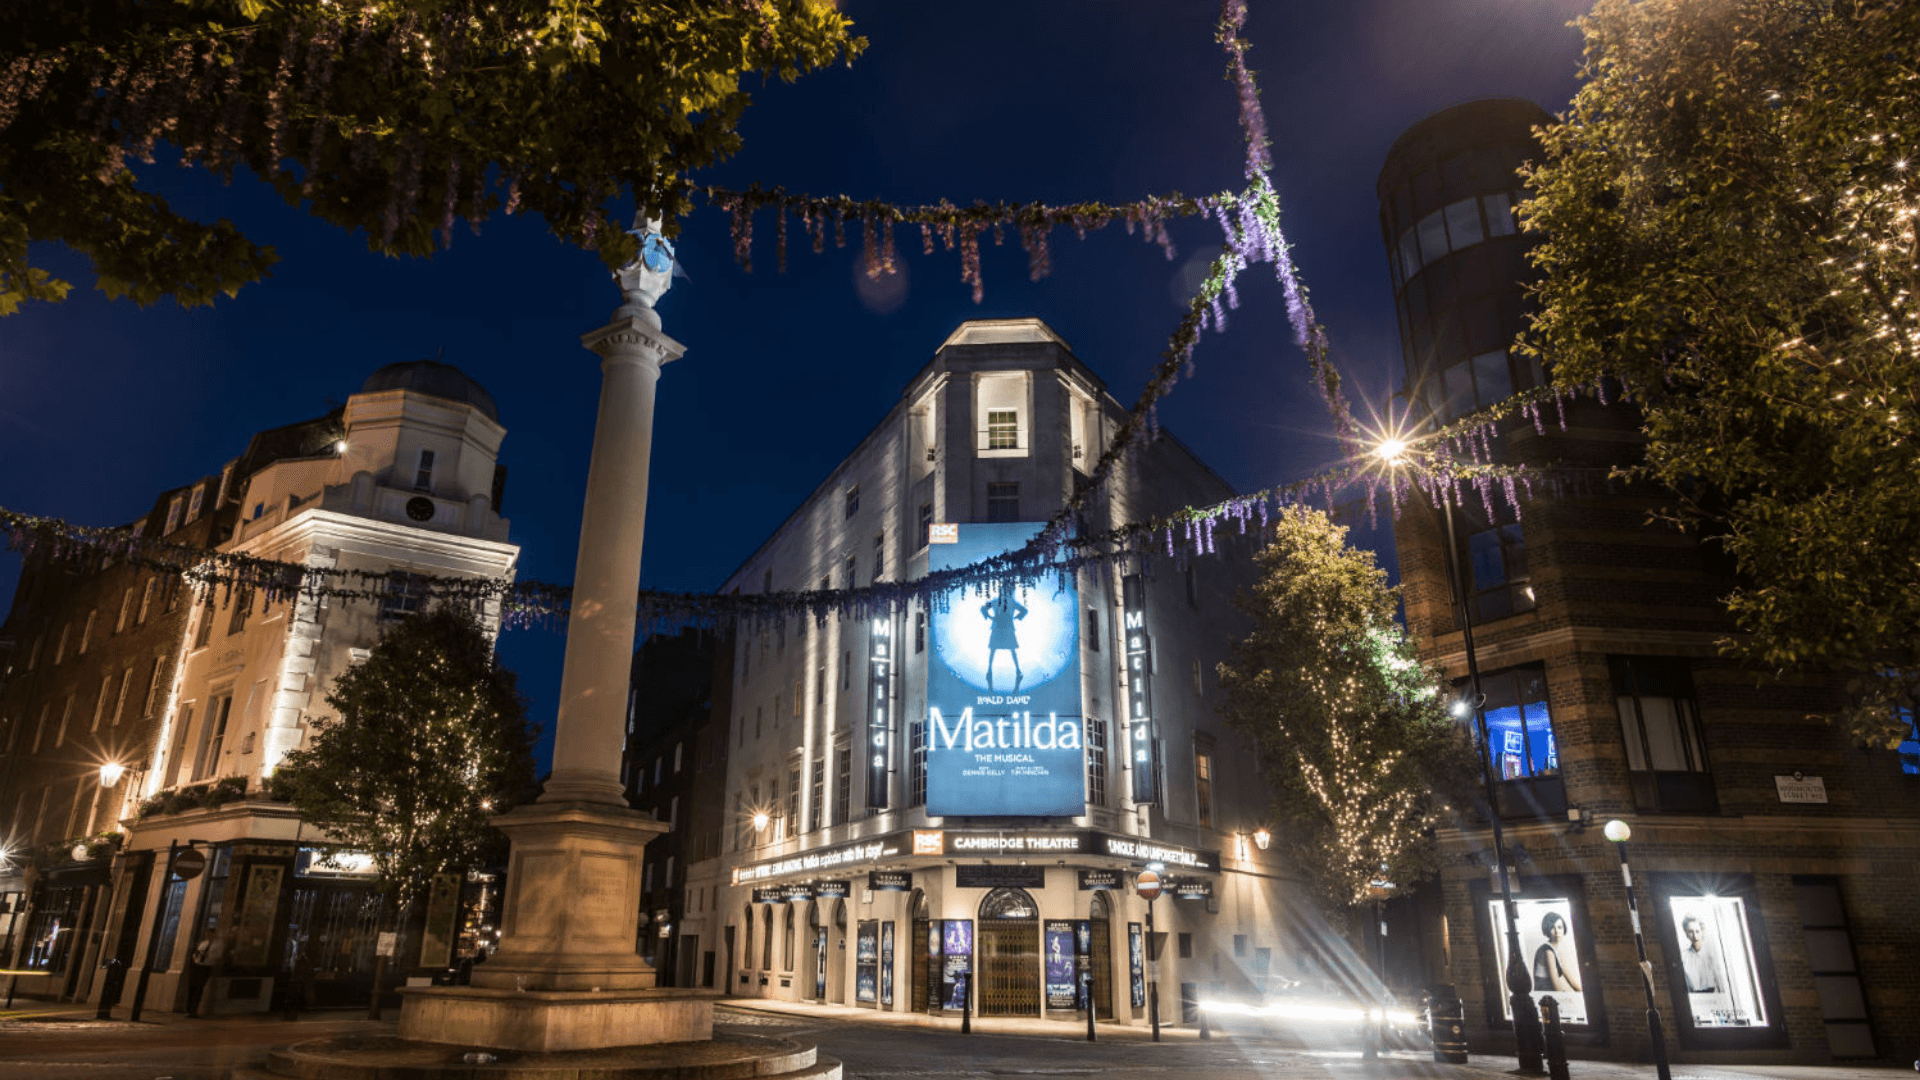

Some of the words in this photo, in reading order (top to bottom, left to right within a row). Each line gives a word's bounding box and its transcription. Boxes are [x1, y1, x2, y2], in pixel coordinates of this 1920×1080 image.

[931, 524, 956, 536] RSC
[872, 617, 890, 768] Matilda
[1126, 611, 1148, 762] Matilda
[928, 706, 1081, 752] Matilda
[975, 754, 992, 762] THE
[994, 754, 1034, 762] MUSICAL
[954, 837, 1024, 849] CAMBRIDGE
[1026, 837, 1079, 849] THEATRE
